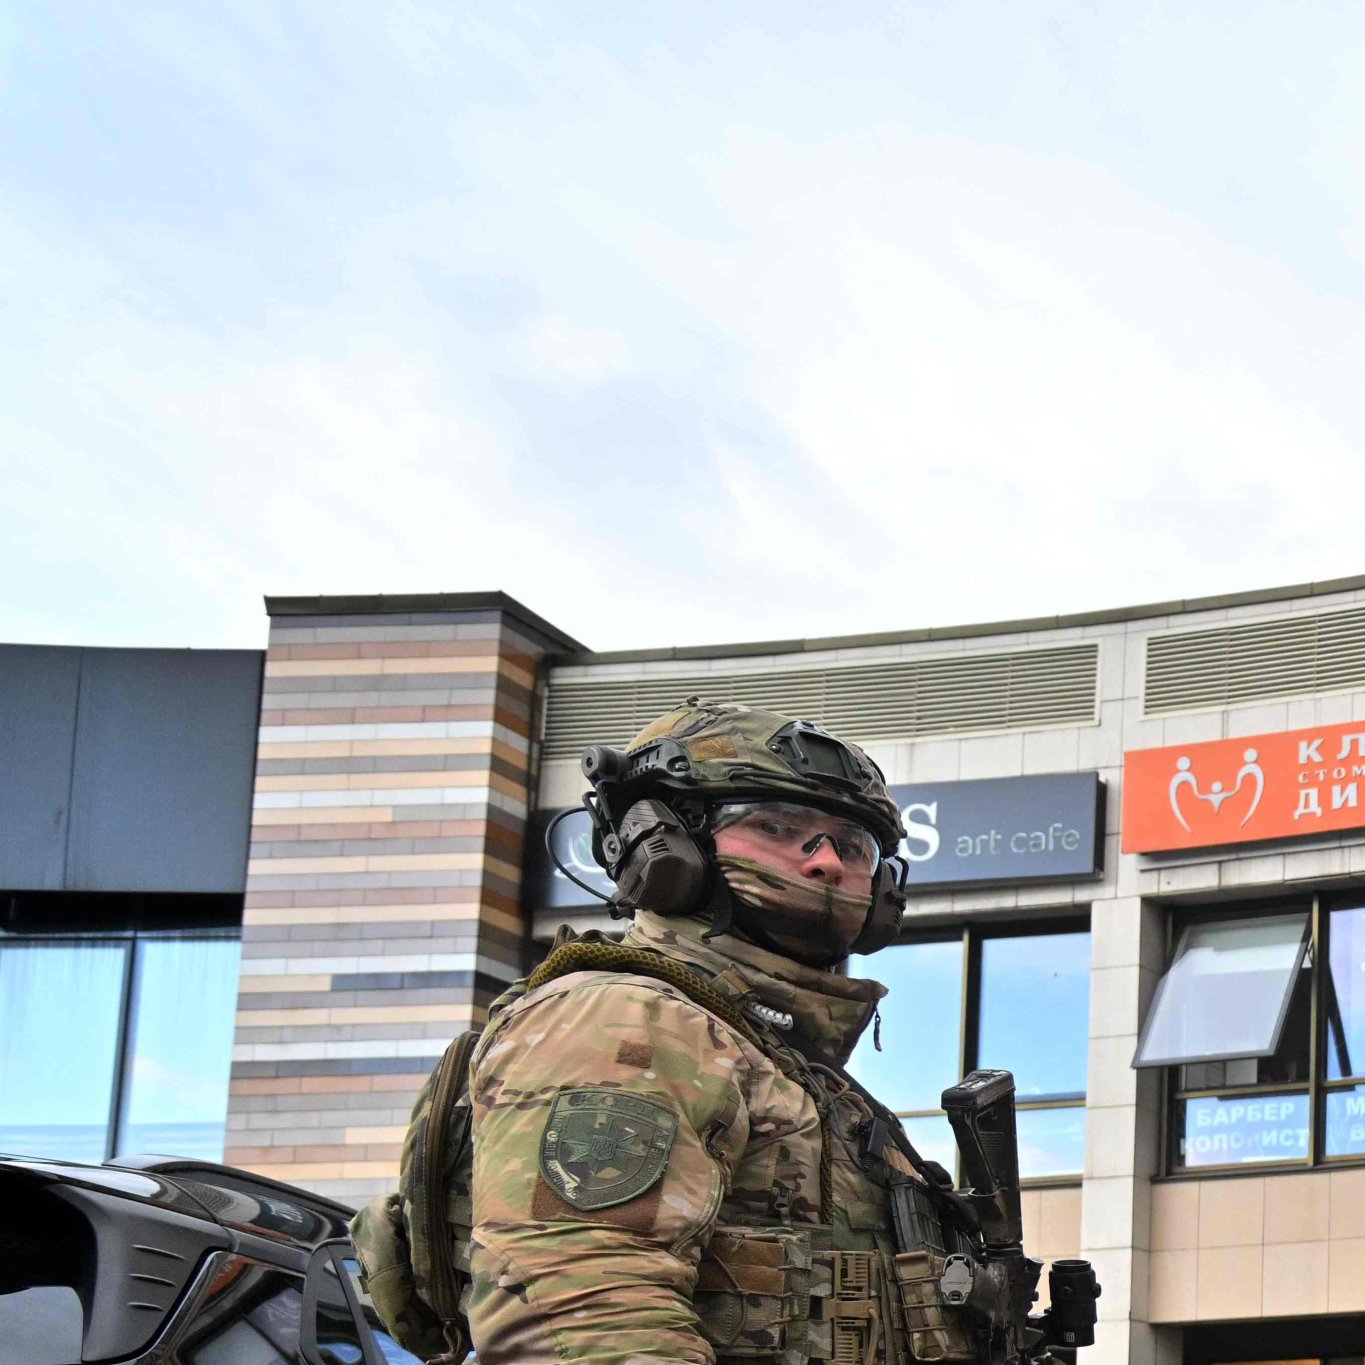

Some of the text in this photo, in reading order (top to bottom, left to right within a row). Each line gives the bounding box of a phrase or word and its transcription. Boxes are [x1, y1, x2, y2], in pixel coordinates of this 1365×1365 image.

[955, 829, 1002, 857] art
[1010, 823, 1080, 853] cafe
[1196, 1102, 1295, 1127] БАРБЕР
